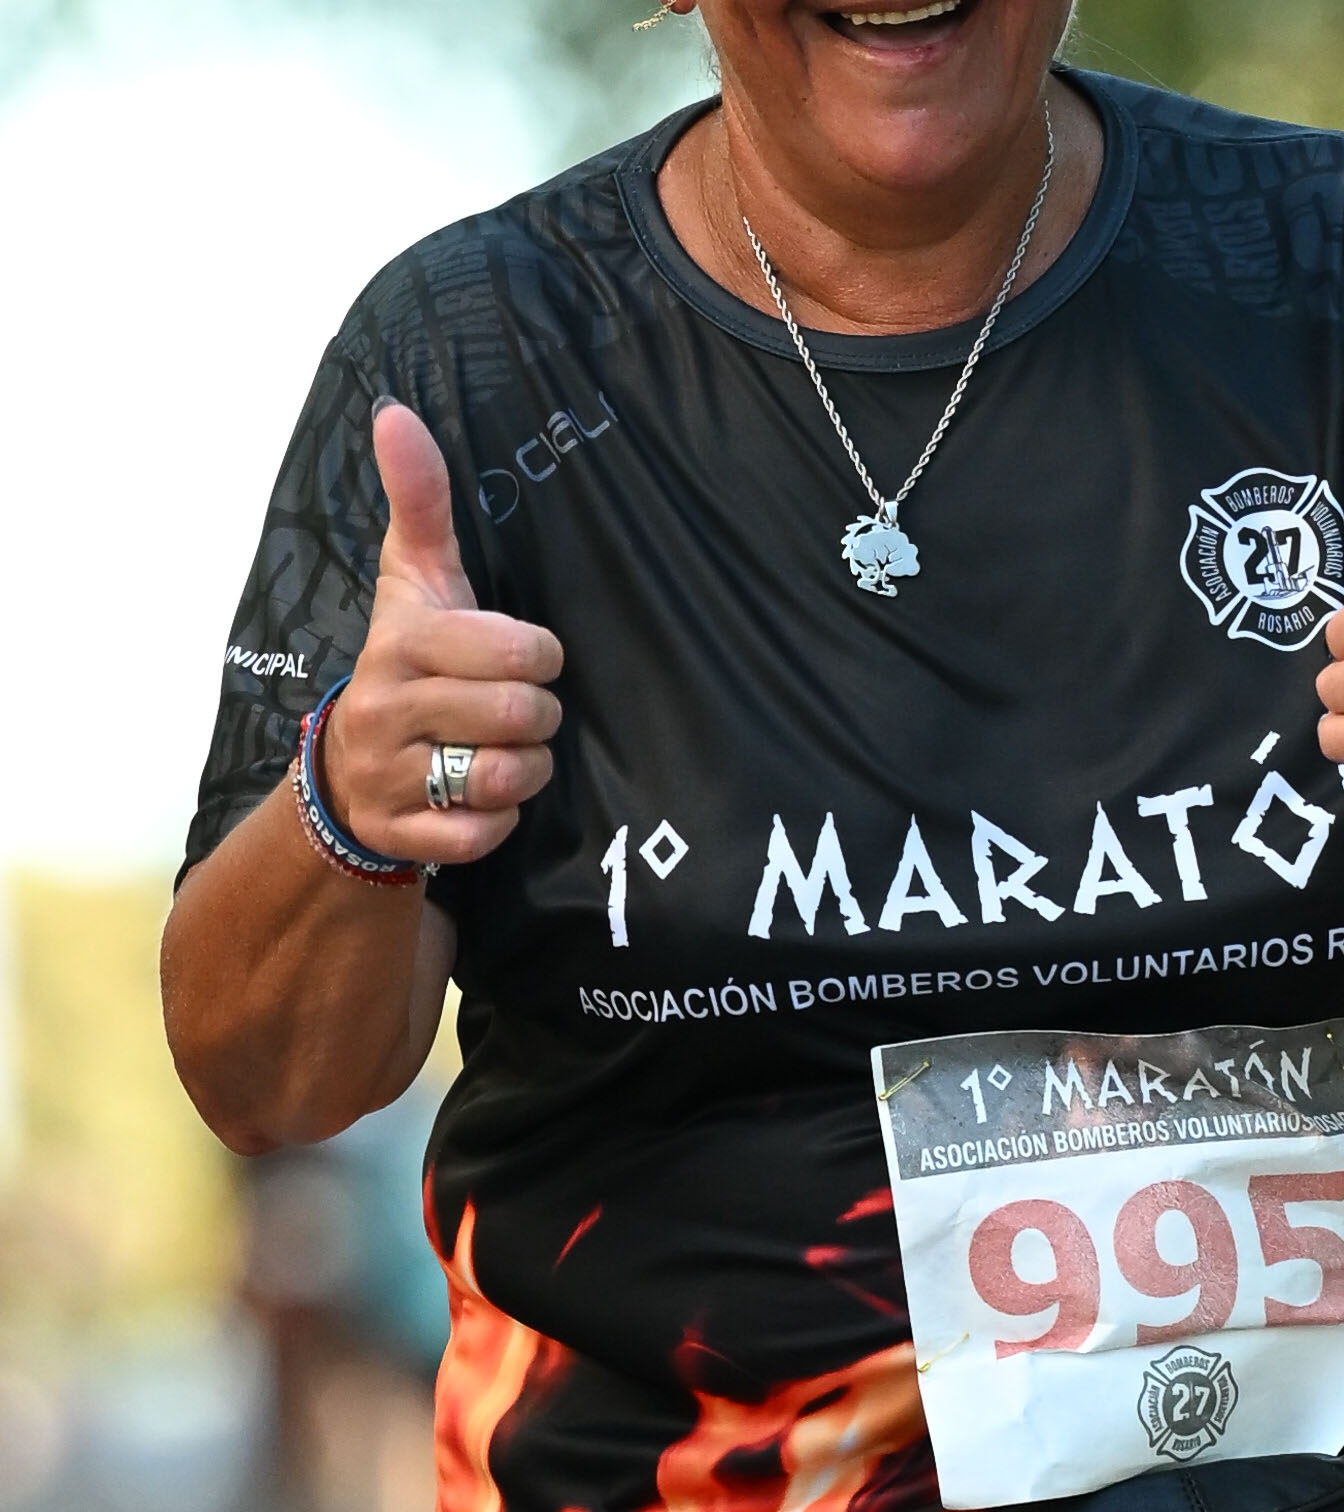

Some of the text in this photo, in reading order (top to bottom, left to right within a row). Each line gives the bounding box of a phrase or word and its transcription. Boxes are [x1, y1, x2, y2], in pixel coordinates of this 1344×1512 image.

[1224, 485, 1295, 513] BOMBEROS
[1196, 525, 1233, 602] ASOCIACIÓN
[1237, 526, 1302, 586] 27
[1309, 501, 1344, 579] VOLUNTARIOS
[1258, 605, 1315, 634] ROSARIO
[309, 804, 397, 873] ROSARIO
[578, 976, 778, 1023] ASOCIACIÓN
[788, 966, 1019, 1010] BOMBEROS
[1033, 932, 1314, 986] VOLUNTARIOS
[1041, 1040, 1313, 1116] MARATÓN
[920, 1129, 1049, 1172] ASOCIACIÓN
[1054, 1117, 1171, 1156] BOMBEROS
[1174, 1111, 1314, 1141] VOLUNTARIOS
[1164, 1355, 1211, 1375] BOMBEROS
[1171, 1382, 1211, 1423] 27
